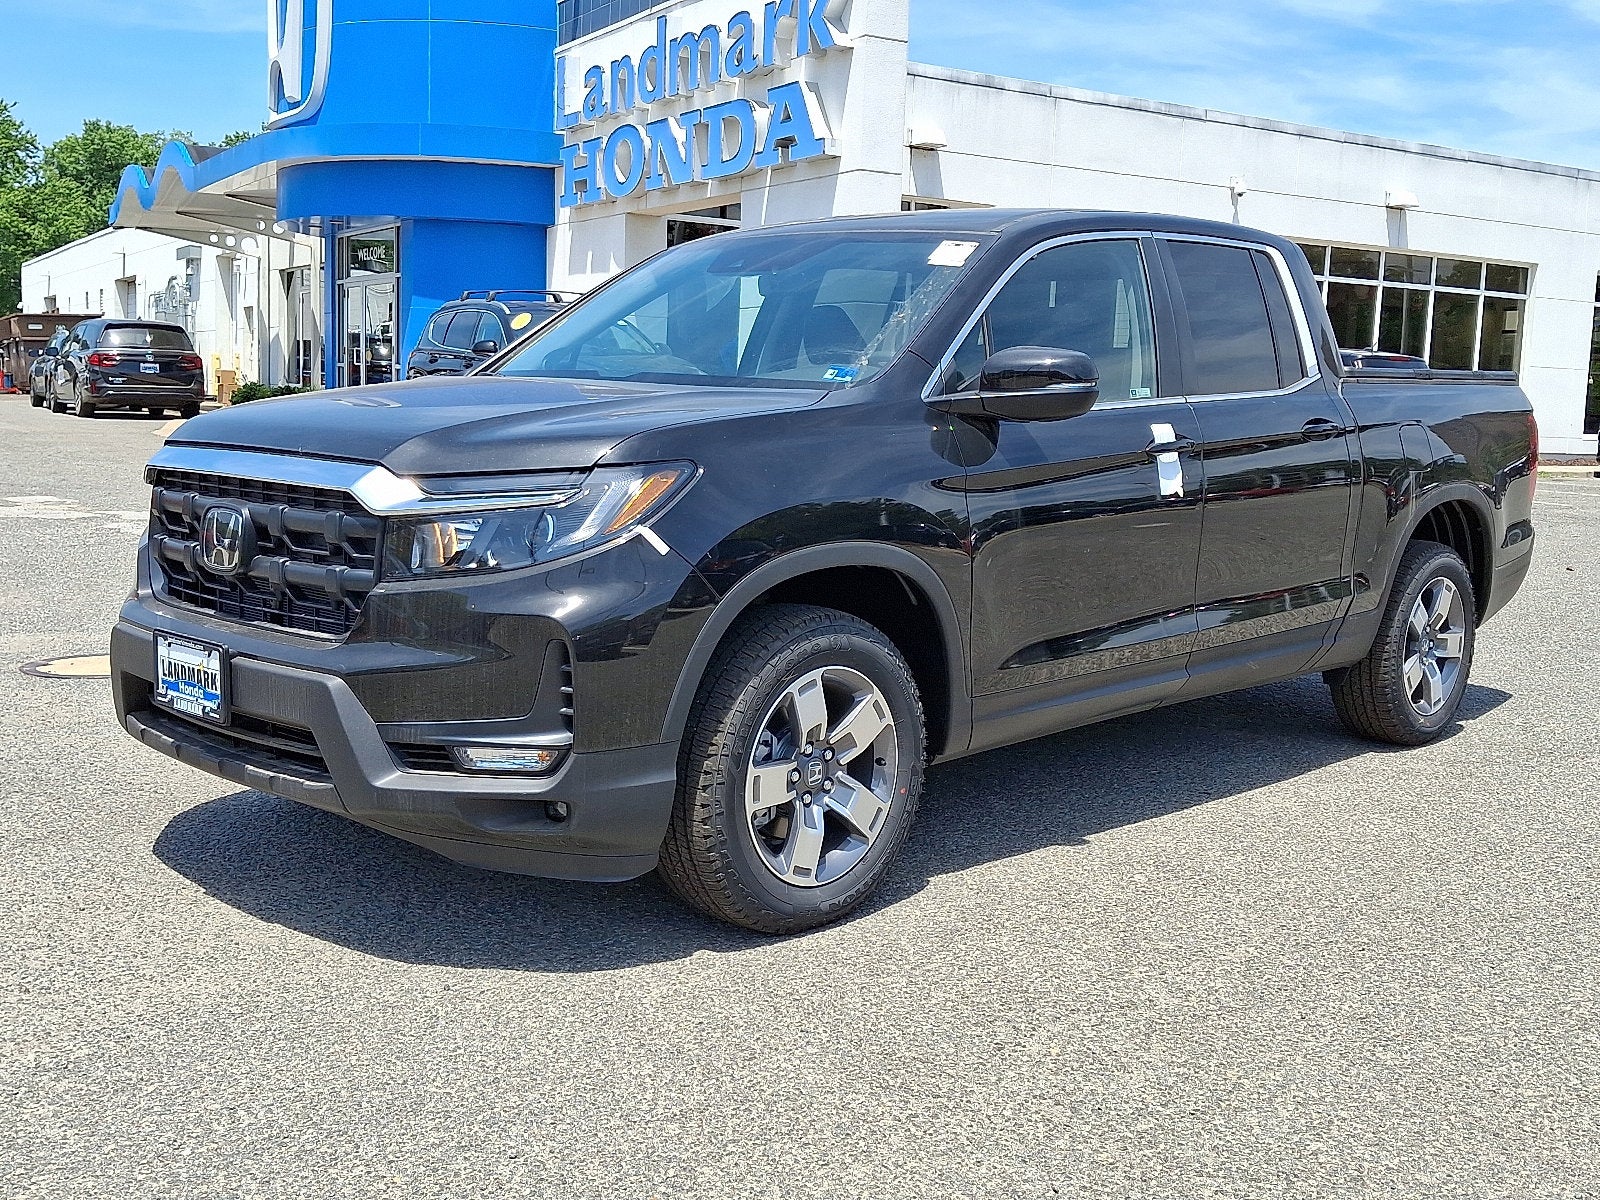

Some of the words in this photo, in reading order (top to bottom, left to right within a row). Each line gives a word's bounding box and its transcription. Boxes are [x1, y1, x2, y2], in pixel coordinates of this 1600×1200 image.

[557, 0, 835, 129] Landmark
[560, 81, 825, 207] HONDA
[357, 245, 386, 261] WELCOME
[162, 658, 217, 692] LANDMARK
[179, 681, 204, 698] Honda
